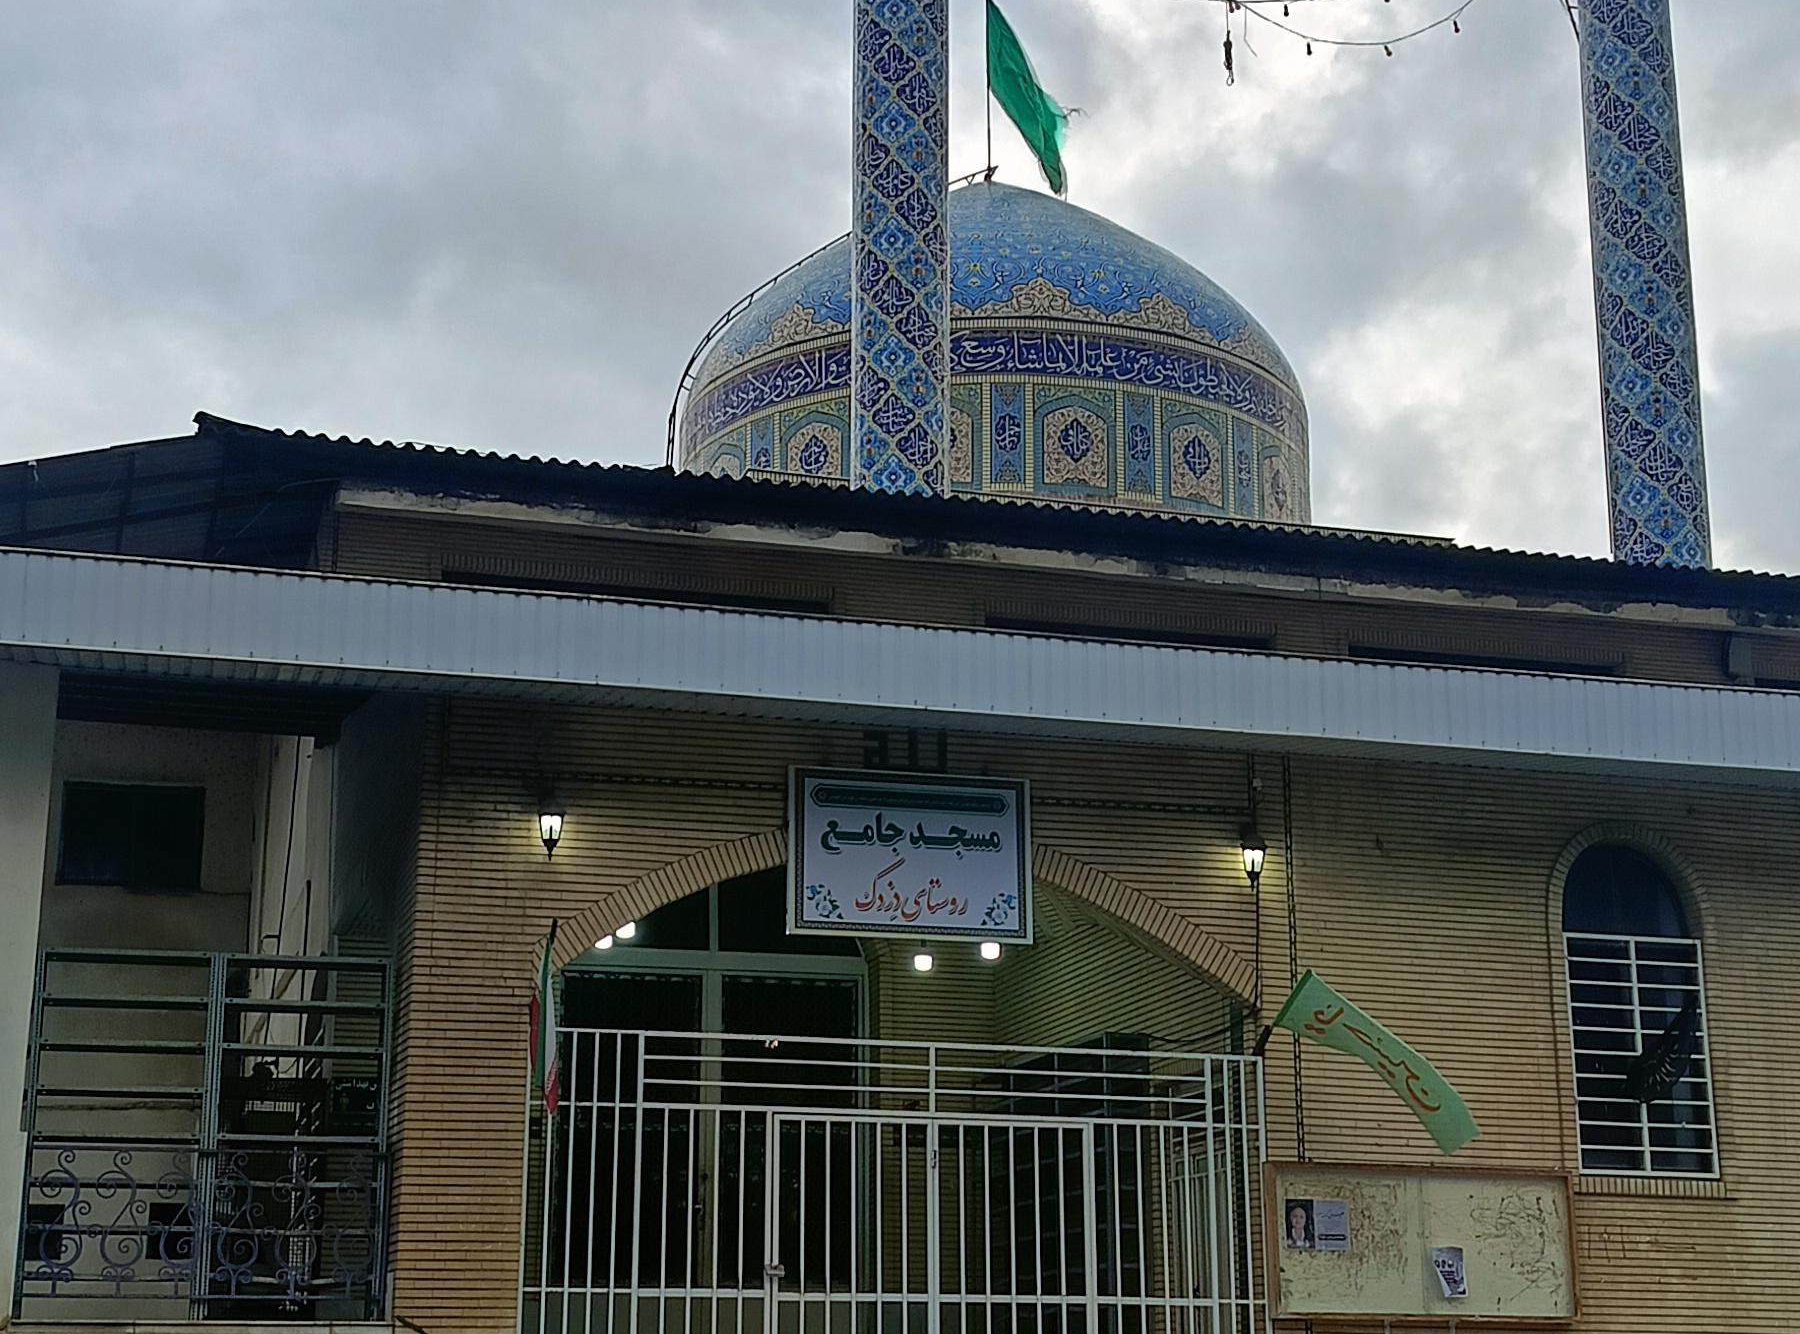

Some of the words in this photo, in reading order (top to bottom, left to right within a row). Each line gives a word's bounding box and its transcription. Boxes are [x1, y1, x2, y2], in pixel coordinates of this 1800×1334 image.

[820, 812, 905, 856] جامع
[909, 821, 1002, 858] مسجد
[901, 878, 968, 922] روستای
